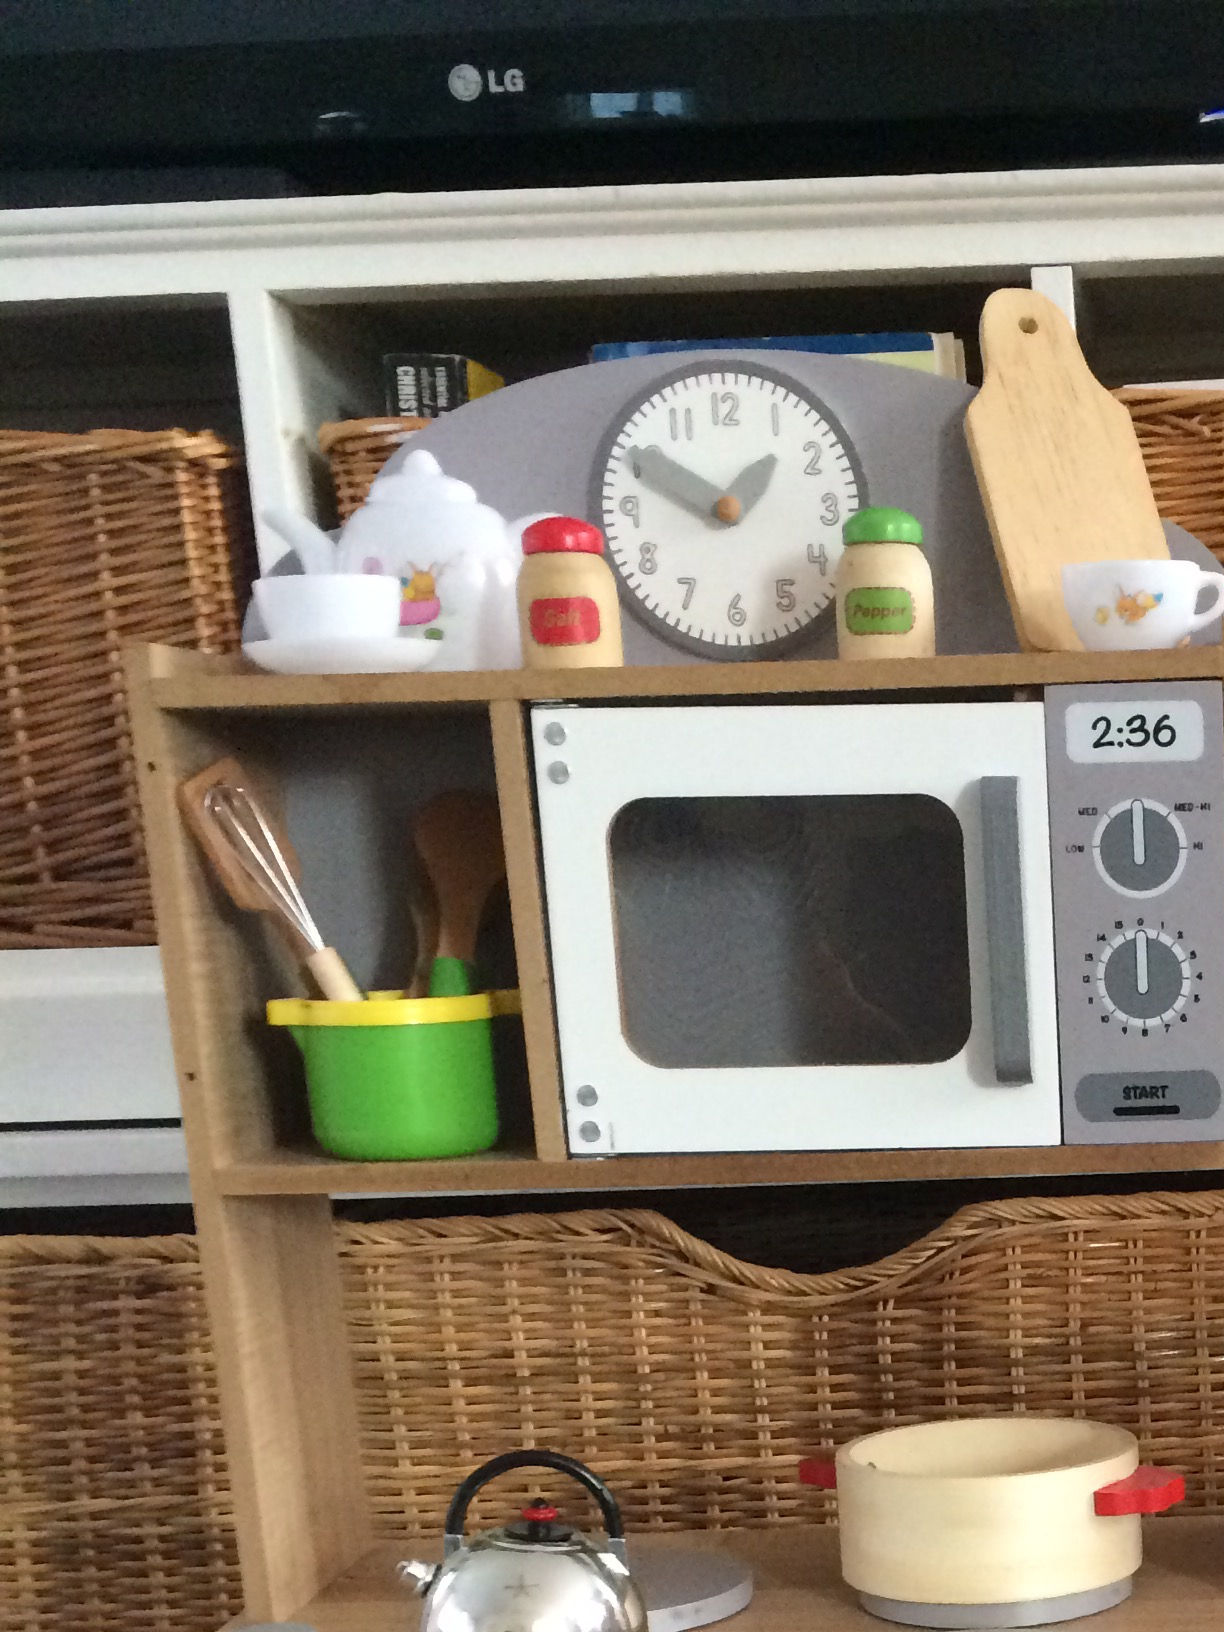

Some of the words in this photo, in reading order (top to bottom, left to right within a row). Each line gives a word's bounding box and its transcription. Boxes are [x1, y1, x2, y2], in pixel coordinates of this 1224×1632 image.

[487, 68, 525, 93] LG
[668, 407, 694, 441] 11
[711, 391, 740, 426] 12
[771, 402, 780, 437] 1
[802, 441, 822, 476] 2
[619, 495, 640, 529] 9
[819, 492, 840, 526] 3
[638, 542, 658, 575] 8
[807, 543, 828, 577] 4
[677, 577, 697, 611] 7
[727, 593, 747, 627] 6
[775, 578, 796, 612] 5
[853, 603, 907, 620] Pepper
[1091, 714, 1177, 749] 2:36
[1137, 918, 1144, 926] 0
[1196, 972, 1203, 981] 4
[1164, 1024, 1171, 1033] 7
[1122, 1085, 1169, 1100] START
